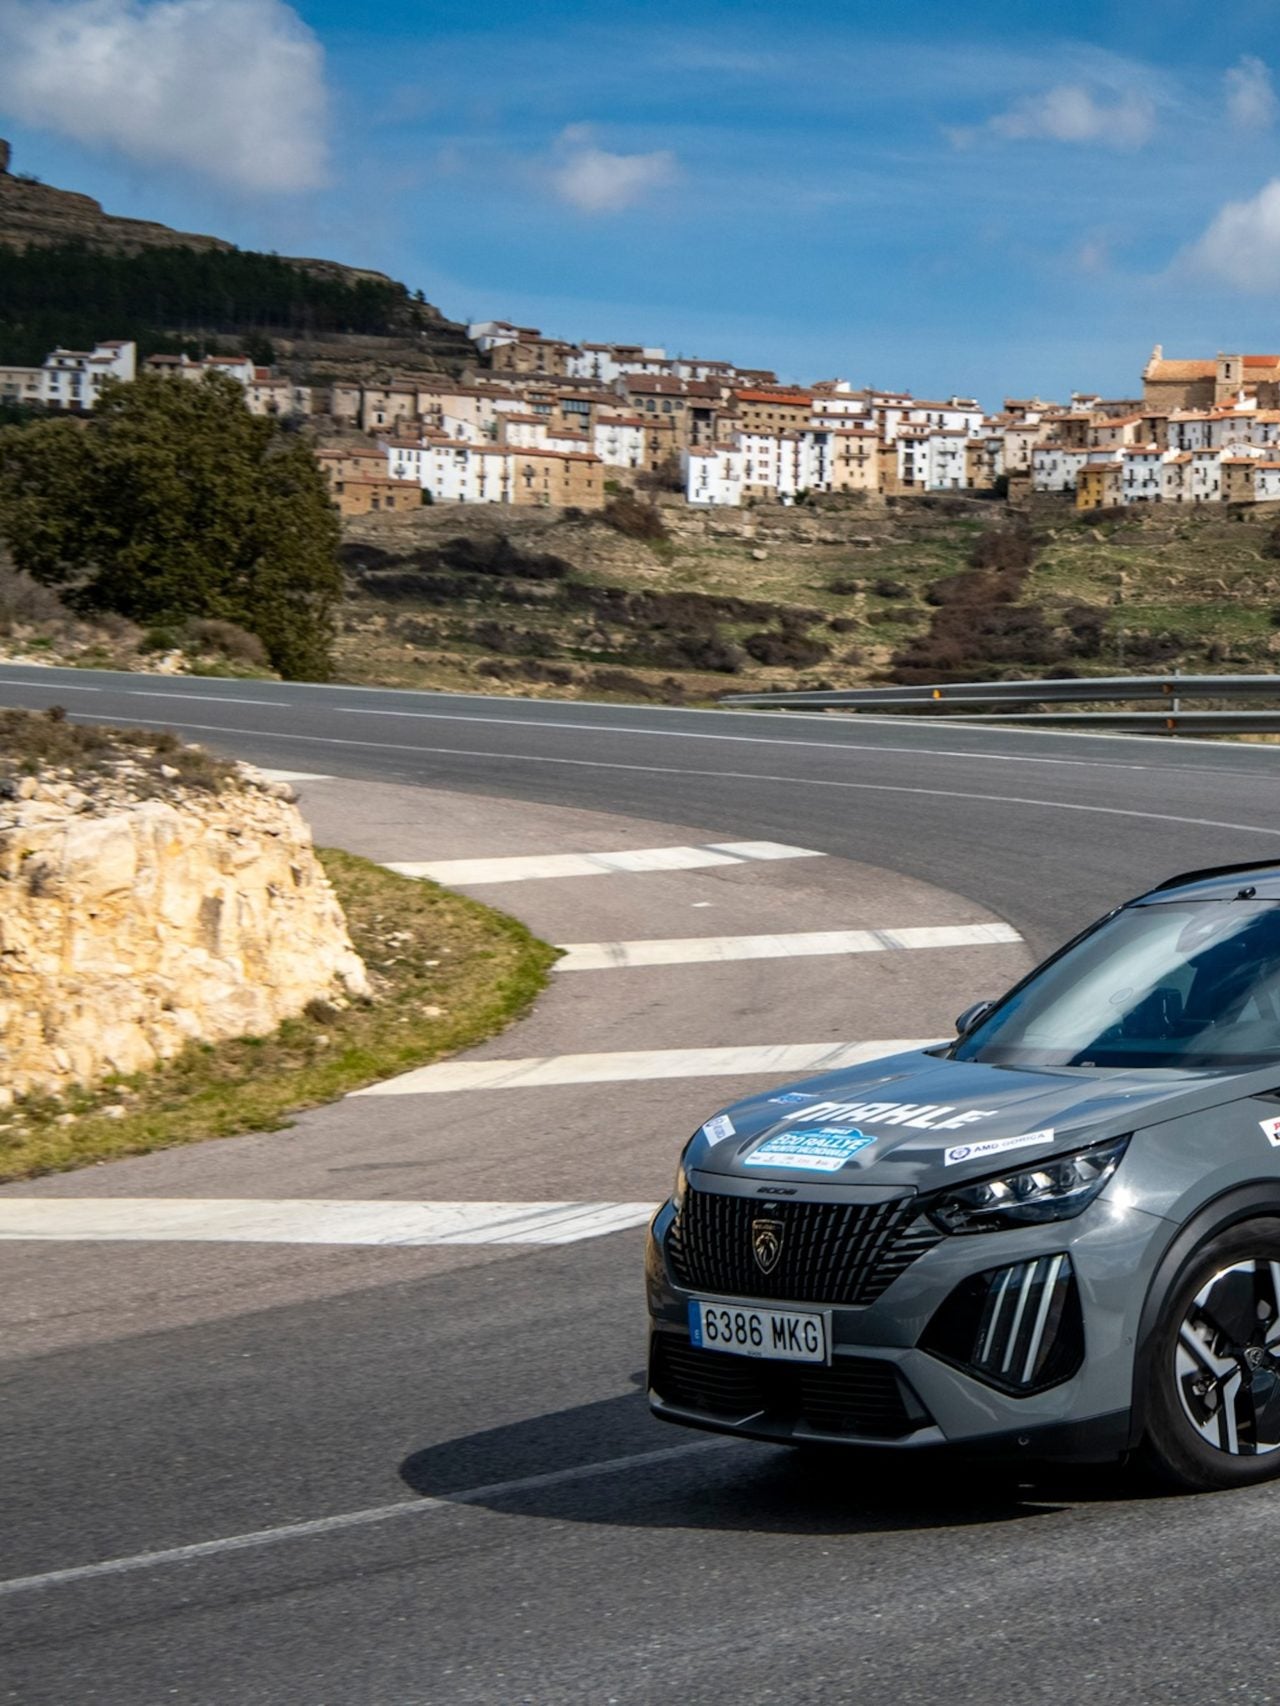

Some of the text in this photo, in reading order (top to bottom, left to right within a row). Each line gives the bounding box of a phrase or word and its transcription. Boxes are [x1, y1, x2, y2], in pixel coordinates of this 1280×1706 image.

[802, 1137, 873, 1150] RALLYE
[974, 1143, 999, 1152] AMD
[705, 1309, 818, 1353] 6386 MKG
